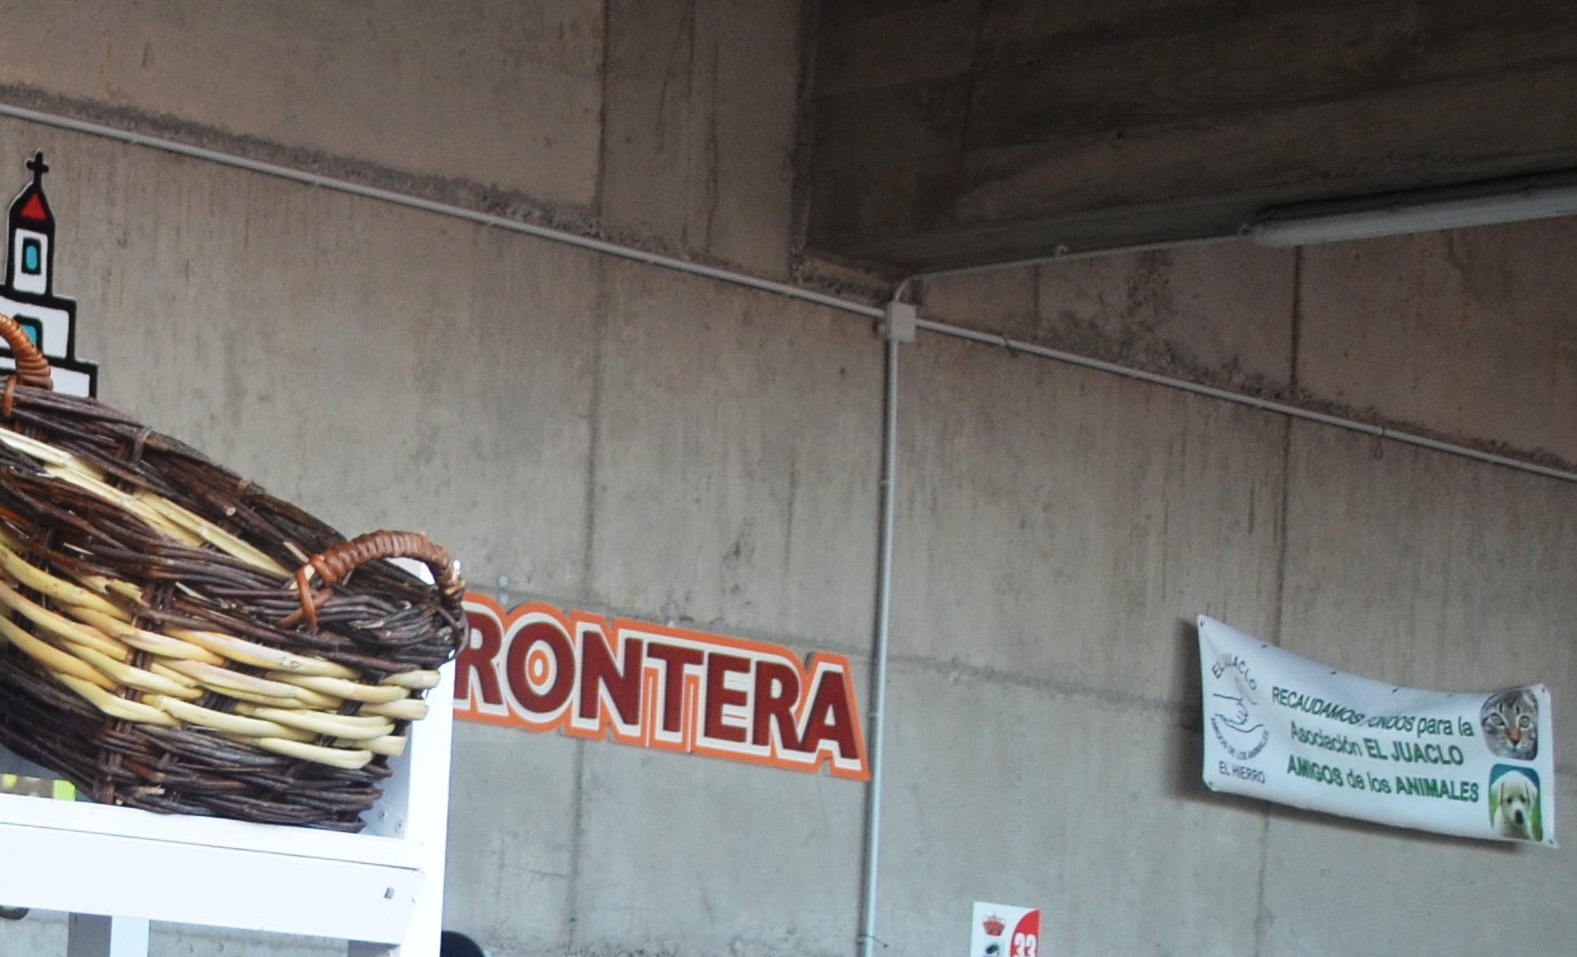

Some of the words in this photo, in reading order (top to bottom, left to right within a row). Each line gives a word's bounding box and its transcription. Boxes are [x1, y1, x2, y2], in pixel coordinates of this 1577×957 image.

[1272, 686, 1365, 725] RECAUDAMOS
[1417, 717, 1453, 738] para
[1458, 716, 1474, 737] la
[1291, 721, 1363, 756] Asociación
[1363, 737, 1388, 760] EL
[1391, 741, 1464, 766] JUACLO
[1219, 760, 1231, 776] EL
[1232, 764, 1266, 784] HIERRO
[1287, 755, 1343, 787] AMIGOS
[1346, 769, 1365, 790] de
[1367, 772, 1392, 794] los
[1395, 776, 1479, 803] ANIMALES
